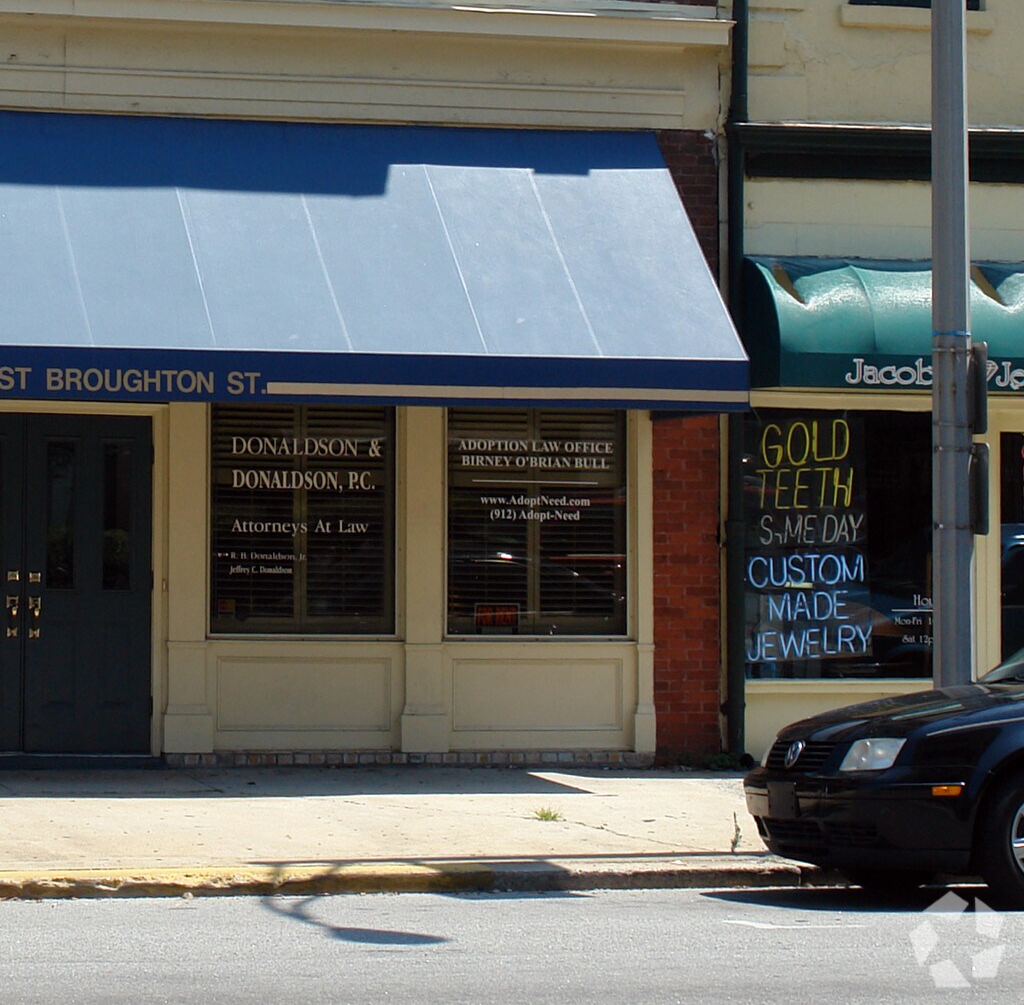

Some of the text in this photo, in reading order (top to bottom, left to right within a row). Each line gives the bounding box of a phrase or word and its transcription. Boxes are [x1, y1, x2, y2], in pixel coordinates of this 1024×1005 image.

[46, 367, 214, 394] BROUGHTON
[226, 371, 267, 395] ST.
[231, 436, 381, 457] DONALDSON &
[458, 439, 614, 454] ADOPTION LAW OFFICE
[762, 419, 850, 468] GOLD
[461, 455, 610, 469] BIRNEY O'BRIAN BULL
[232, 469, 376, 493] DONALDSON, P.C.
[755, 467, 853, 509] TEETH
[480, 495, 591, 508] www.AdoptNeed.com
[231, 519, 369, 537] Attorneys At Law
[490, 508, 580, 522] (912) Adopt-Need
[822, 514, 864, 543] DAY
[748, 554, 864, 588] CUSTOM
[769, 590, 849, 622] MADE
[747, 624, 872, 662] JEWELRY
